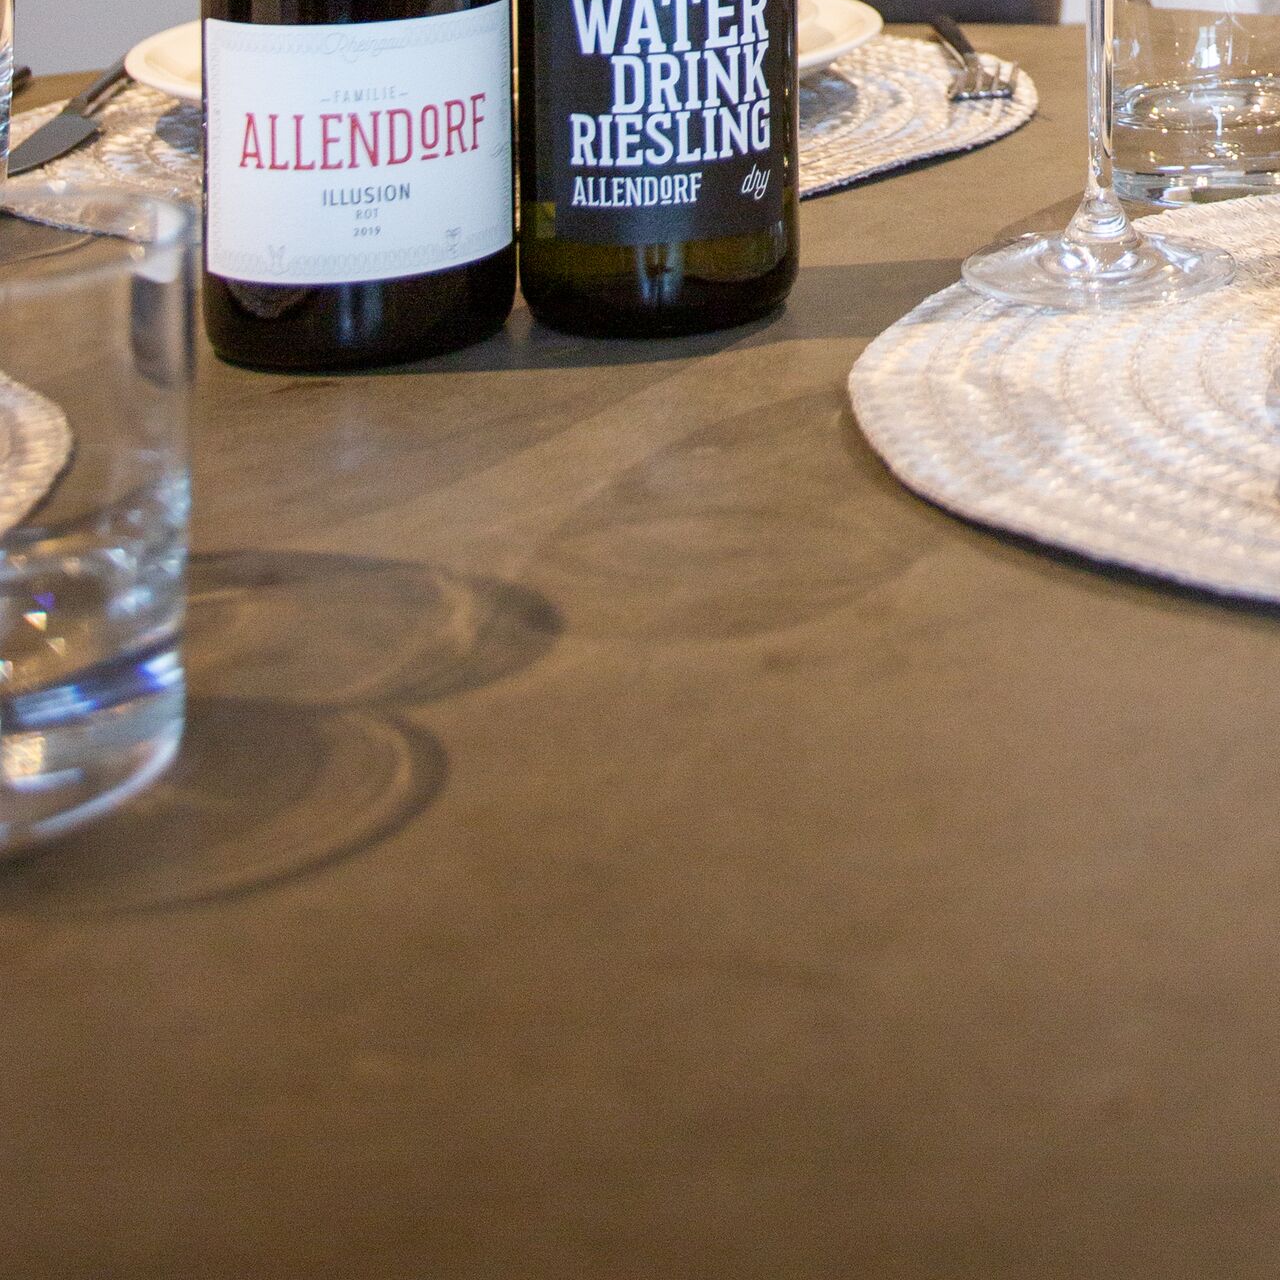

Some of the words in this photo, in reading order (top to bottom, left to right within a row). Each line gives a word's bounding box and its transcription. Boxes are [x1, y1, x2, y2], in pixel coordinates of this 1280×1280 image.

[333, 85, 397, 103] FAMILIE
[611, 40, 770, 114] DRINK
[238, 92, 487, 171] ALLENDORF
[569, 98, 771, 167] RIESLING
[322, 183, 412, 207] ILLUSION
[571, 171, 703, 207] ALLENDORF
[741, 163, 770, 200] dry
[353, 225, 382, 237] 2019
[355, 207, 380, 220] ROT
